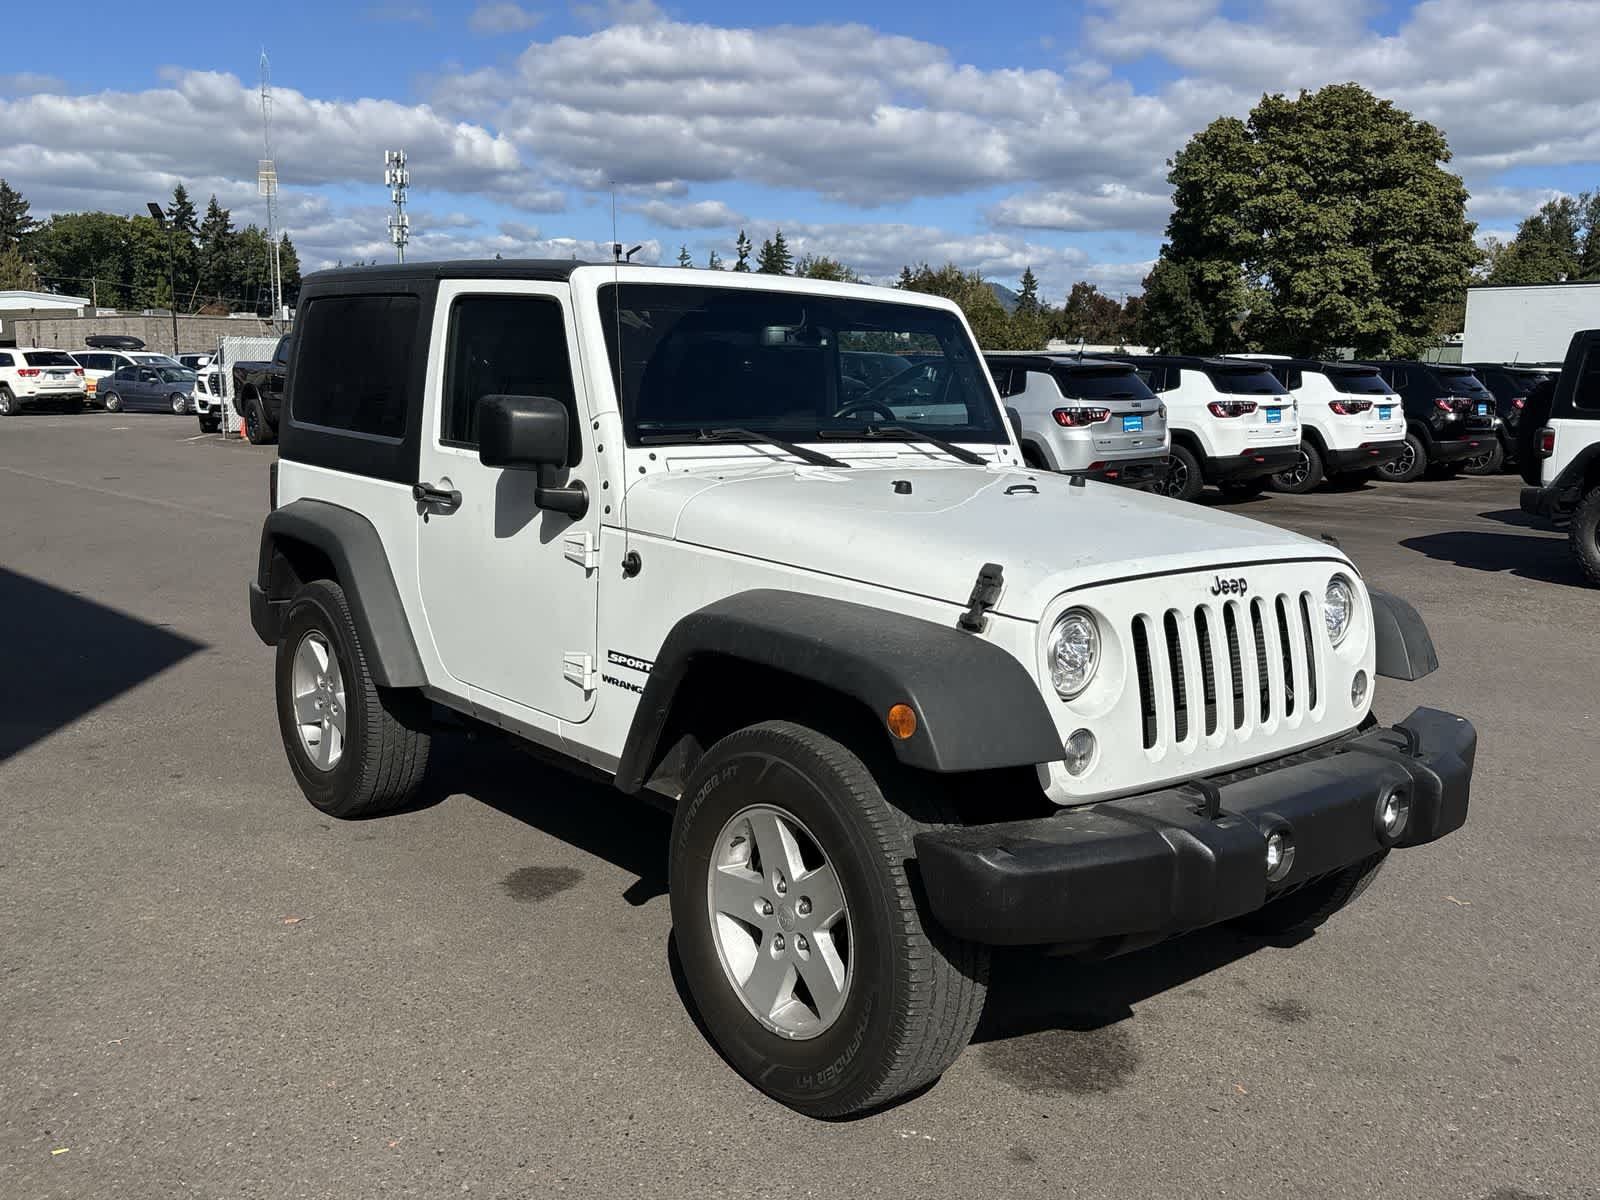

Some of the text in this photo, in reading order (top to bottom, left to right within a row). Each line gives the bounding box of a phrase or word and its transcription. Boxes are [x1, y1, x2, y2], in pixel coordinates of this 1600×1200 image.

[1211, 575, 1248, 597] Jeep
[609, 652, 654, 672] SPORT
[601, 673, 644, 695] WRANG
